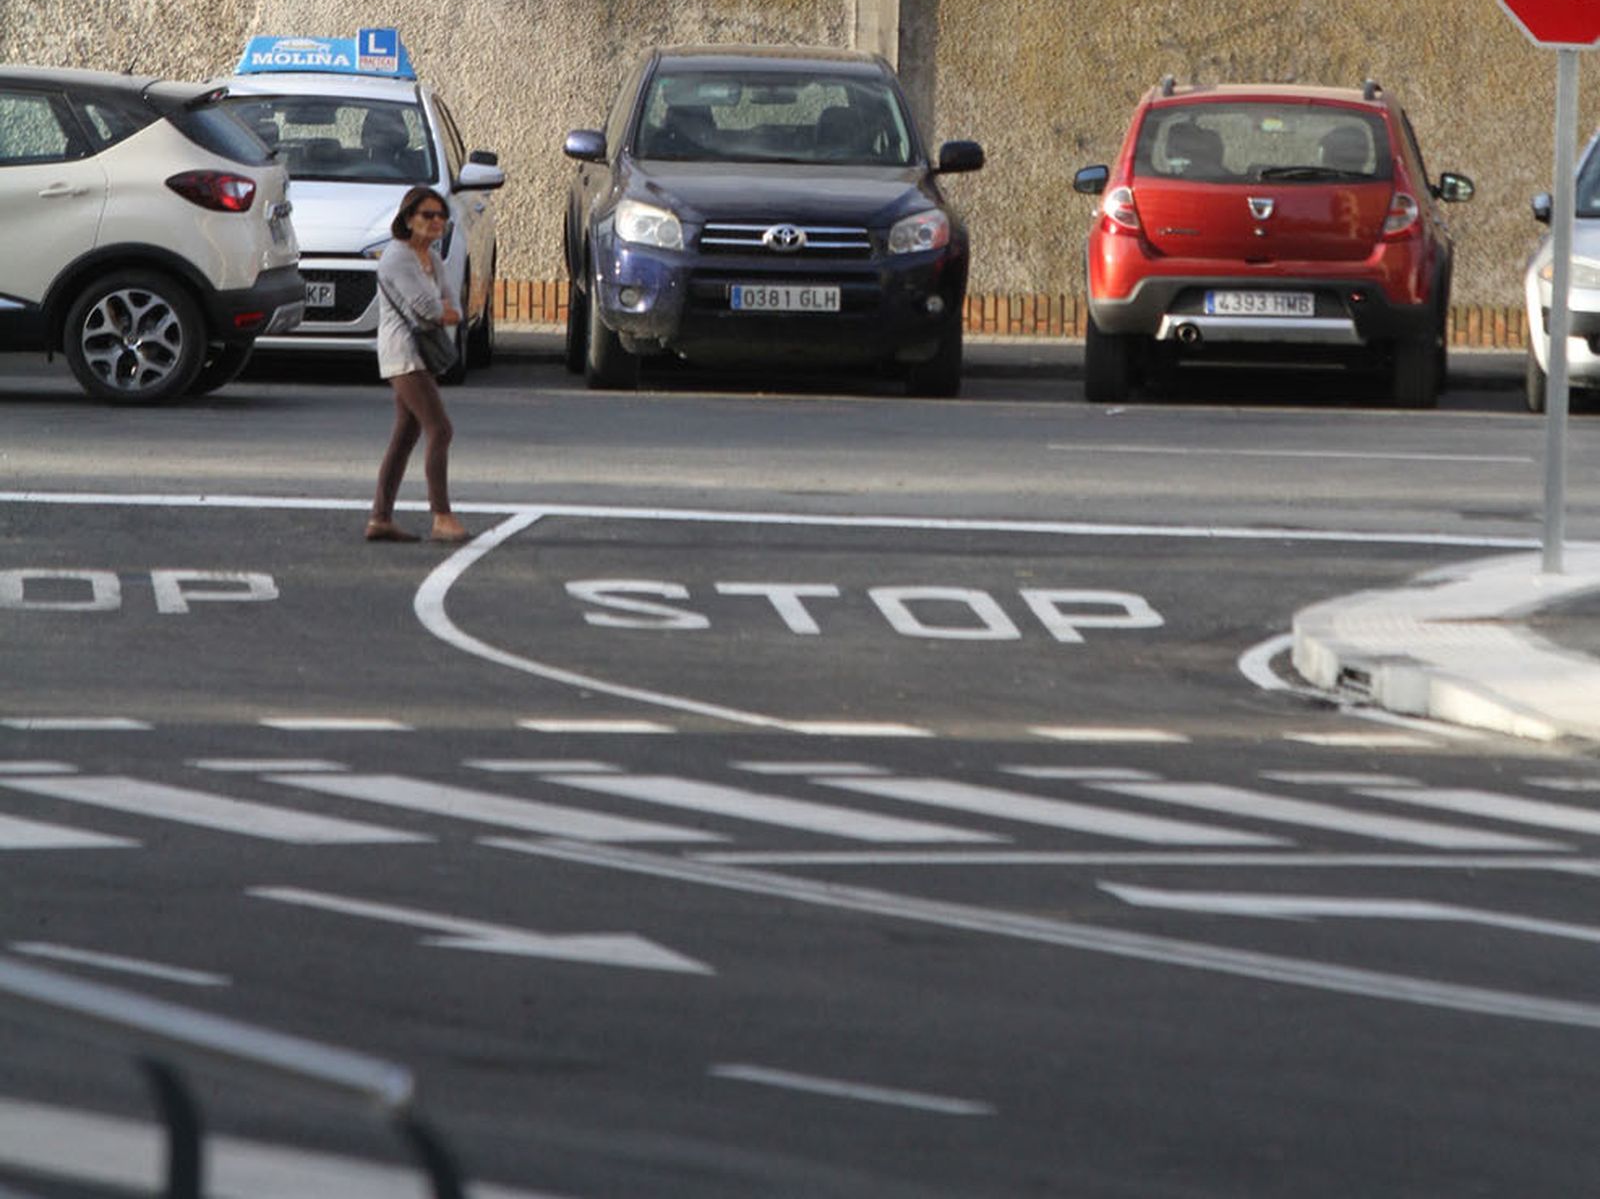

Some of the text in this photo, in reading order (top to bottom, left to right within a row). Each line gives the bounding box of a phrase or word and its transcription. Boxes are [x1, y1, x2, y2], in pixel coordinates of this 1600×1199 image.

[368, 32, 388, 54] L
[251, 52, 350, 67] MOLINA
[744, 290, 837, 308] 0381 GLH
[1219, 293, 1310, 313] 4393 HMB
[565, 579, 1165, 643] STOP
